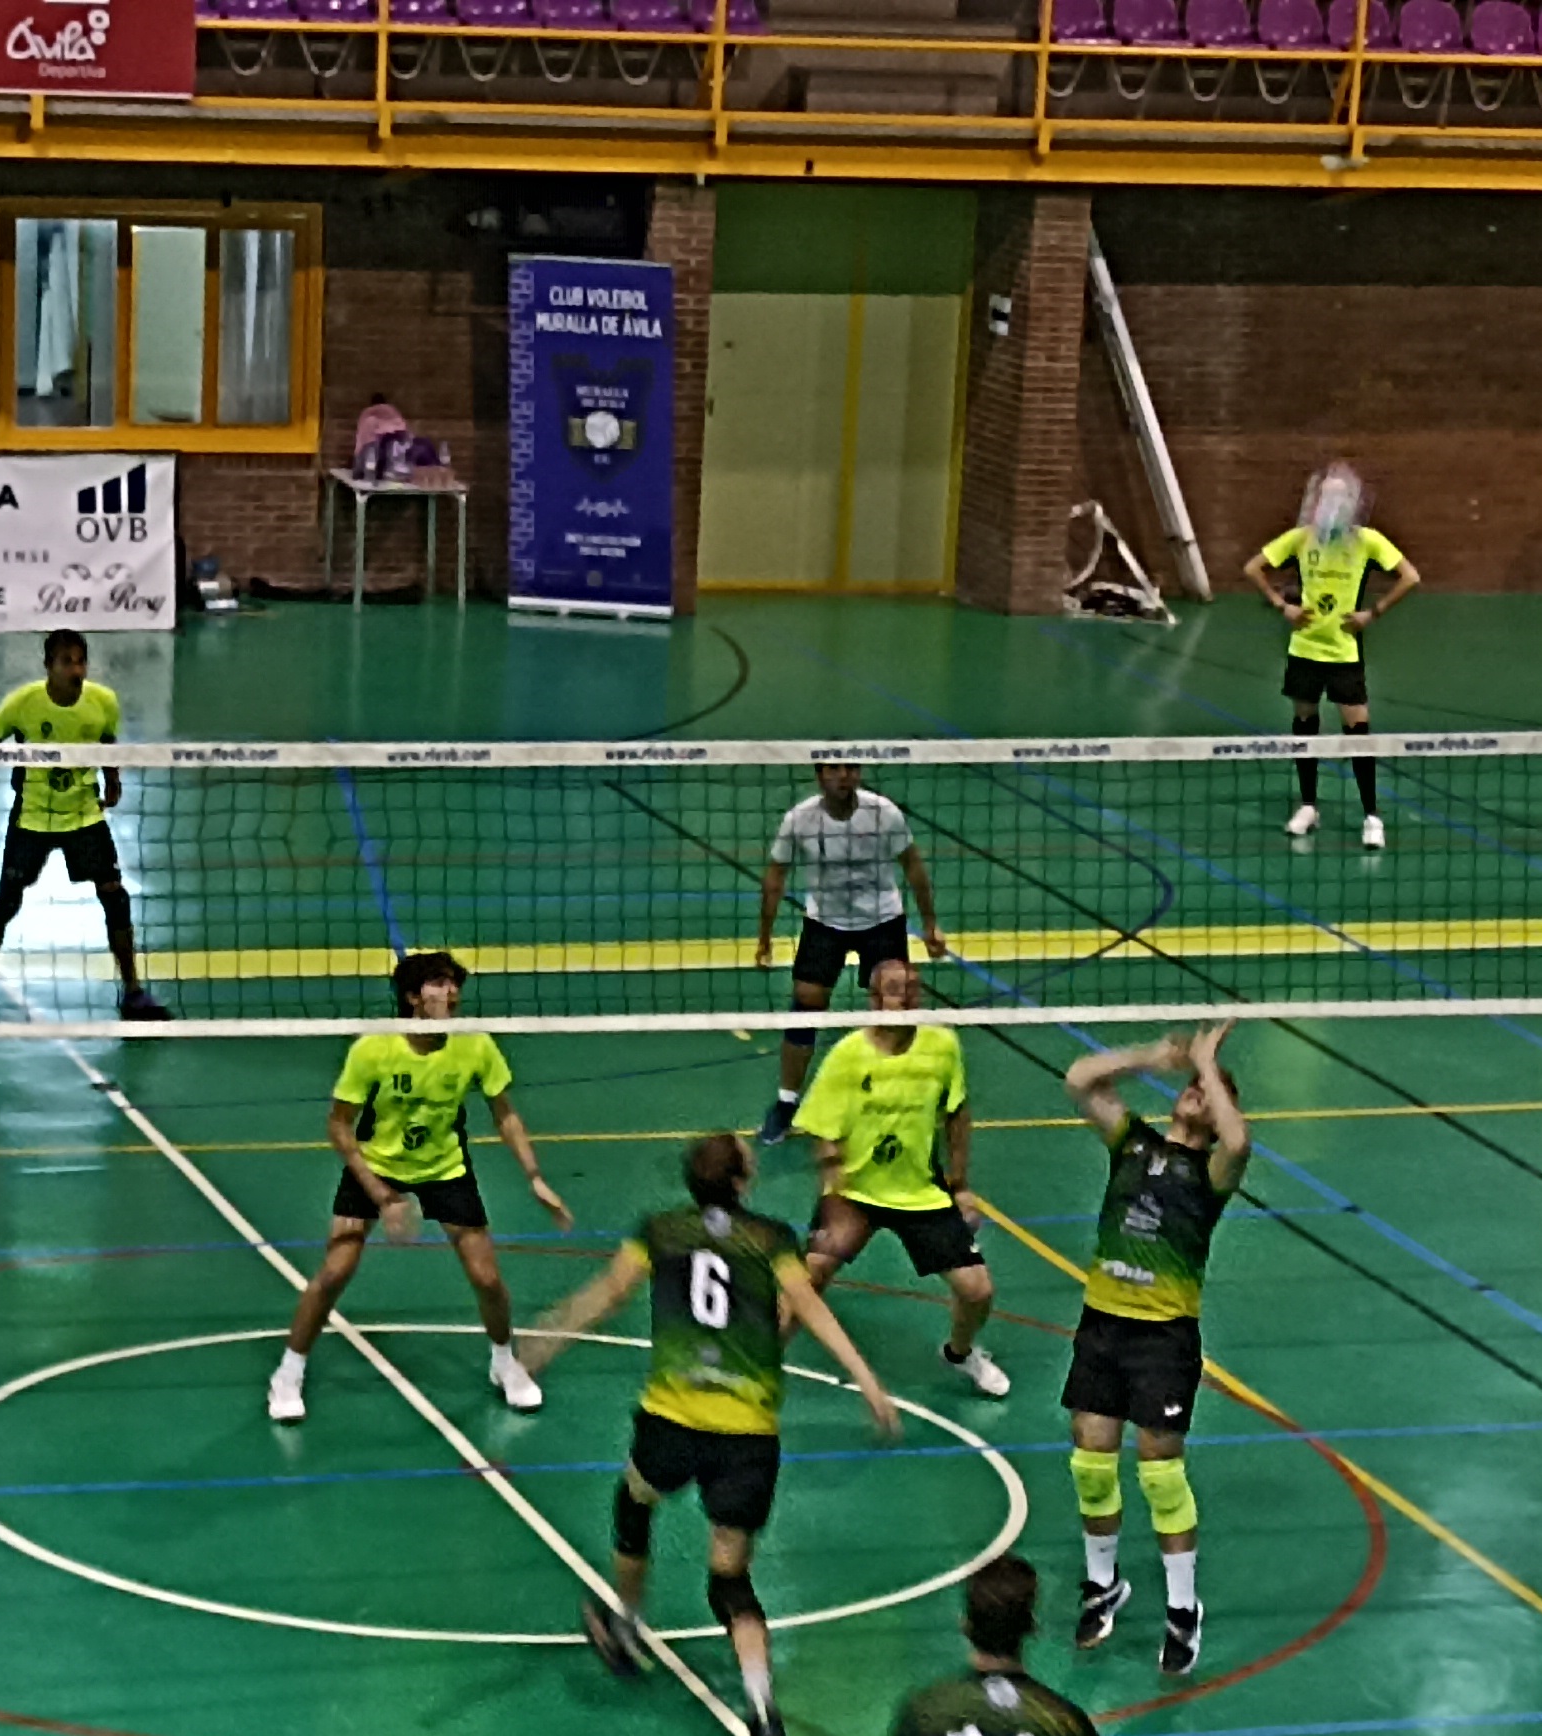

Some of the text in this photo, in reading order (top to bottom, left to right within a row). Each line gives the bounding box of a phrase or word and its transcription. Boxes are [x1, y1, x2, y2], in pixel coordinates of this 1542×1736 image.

[549, 285, 648, 311] CLUB VOLEIBOL
[535, 312, 663, 338] MURALLA DE ÁVILA
[76, 516, 148, 543] OVB
[689, 1248, 731, 1329] 6
